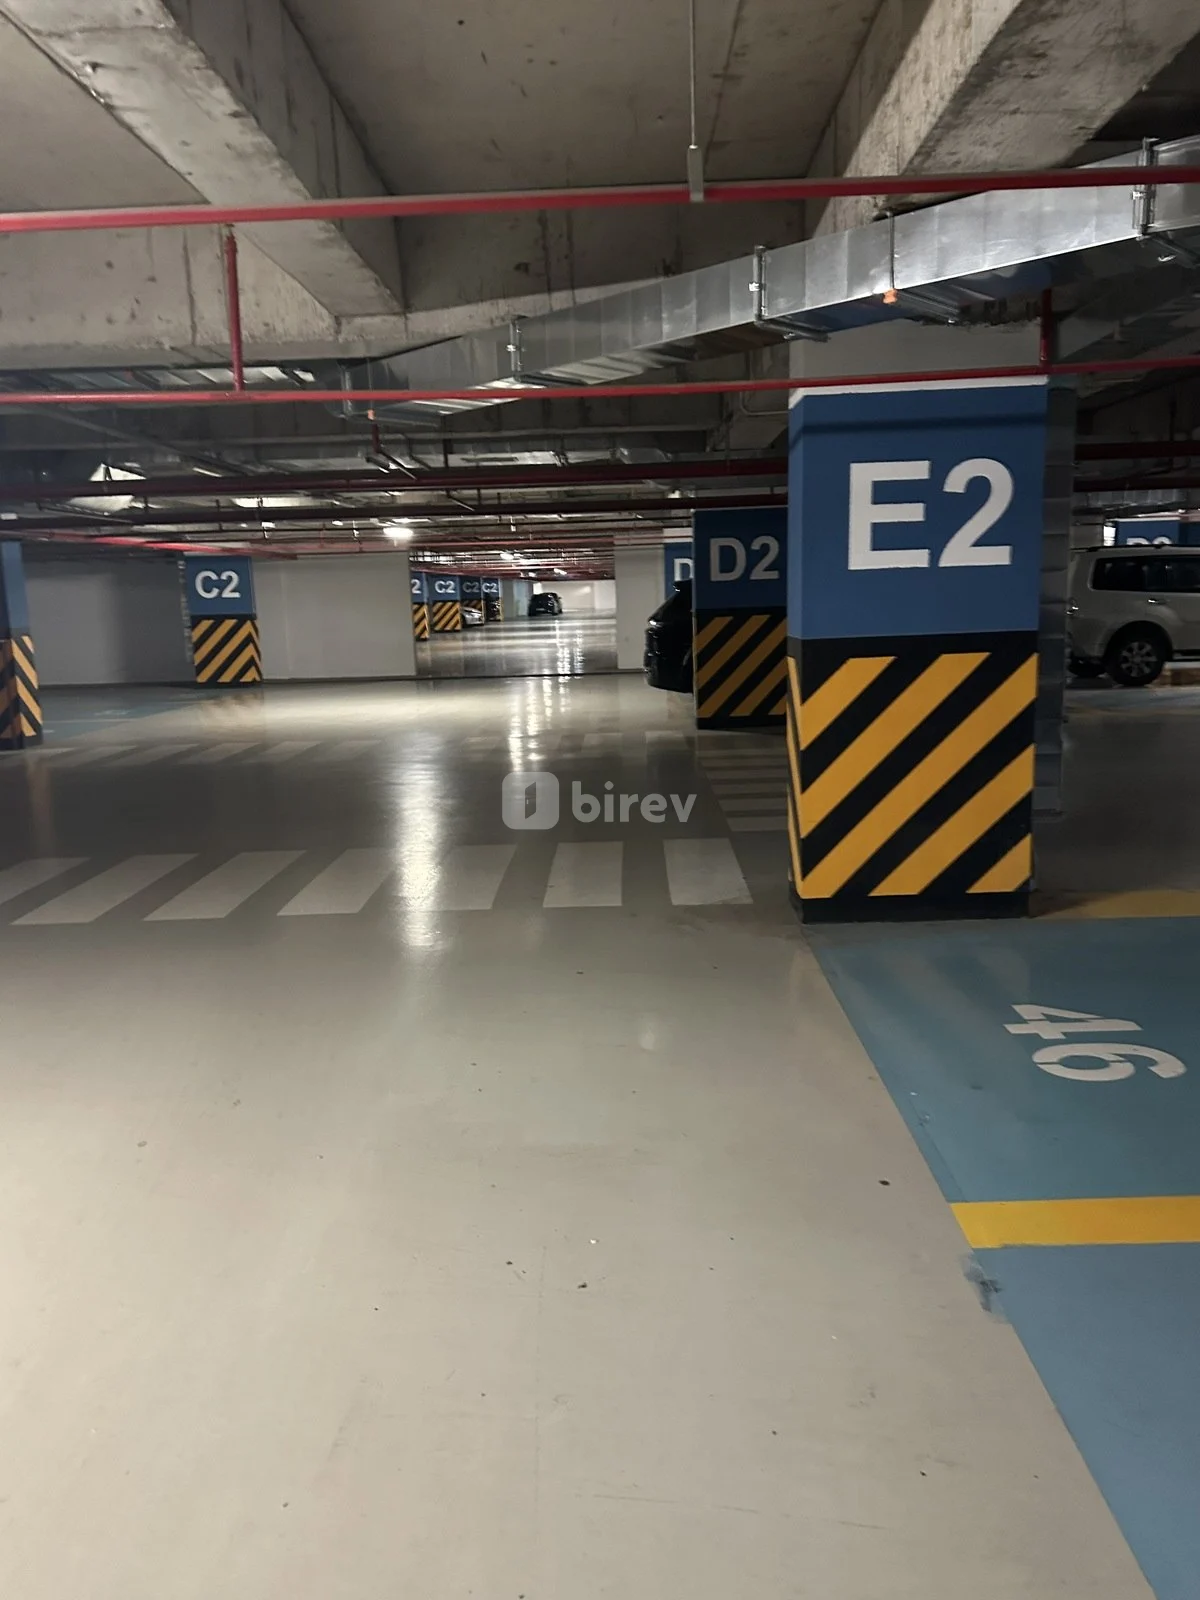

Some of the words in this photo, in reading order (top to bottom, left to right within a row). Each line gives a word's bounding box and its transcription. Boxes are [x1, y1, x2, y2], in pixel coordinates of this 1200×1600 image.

[848, 457, 1014, 570] E2
[709, 535, 780, 582] D2
[195, 570, 241, 598] C2
[434, 580, 456, 593] C2
[462, 582, 480, 593] C2
[481, 582, 498, 593] C2
[1002, 1004, 1187, 1081] 46
